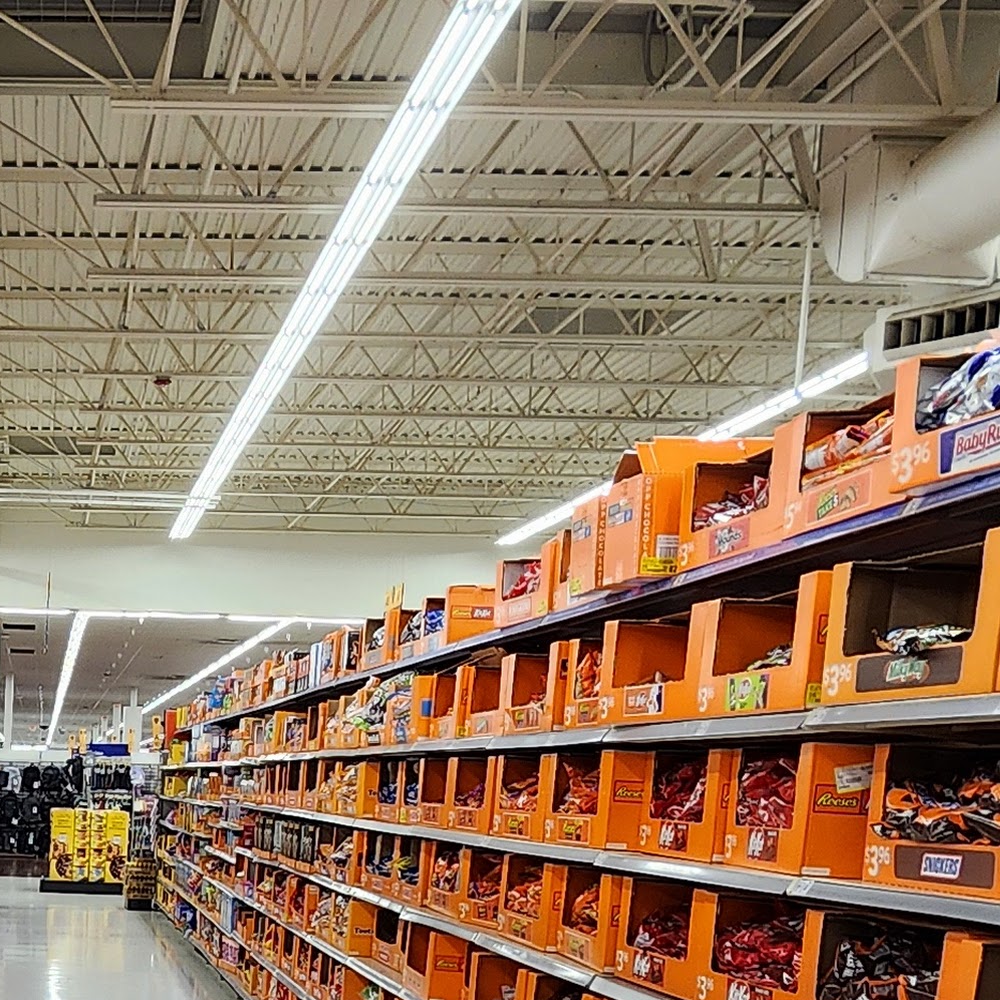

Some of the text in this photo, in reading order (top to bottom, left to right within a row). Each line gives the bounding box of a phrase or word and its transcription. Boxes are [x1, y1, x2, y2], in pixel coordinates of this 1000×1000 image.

[892, 441, 931, 484] $396
[822, 663, 852, 696] $396
[816, 793, 858, 808] Reese's
[866, 845, 891, 877] $396
[922, 853, 960, 876] SNICKERS
